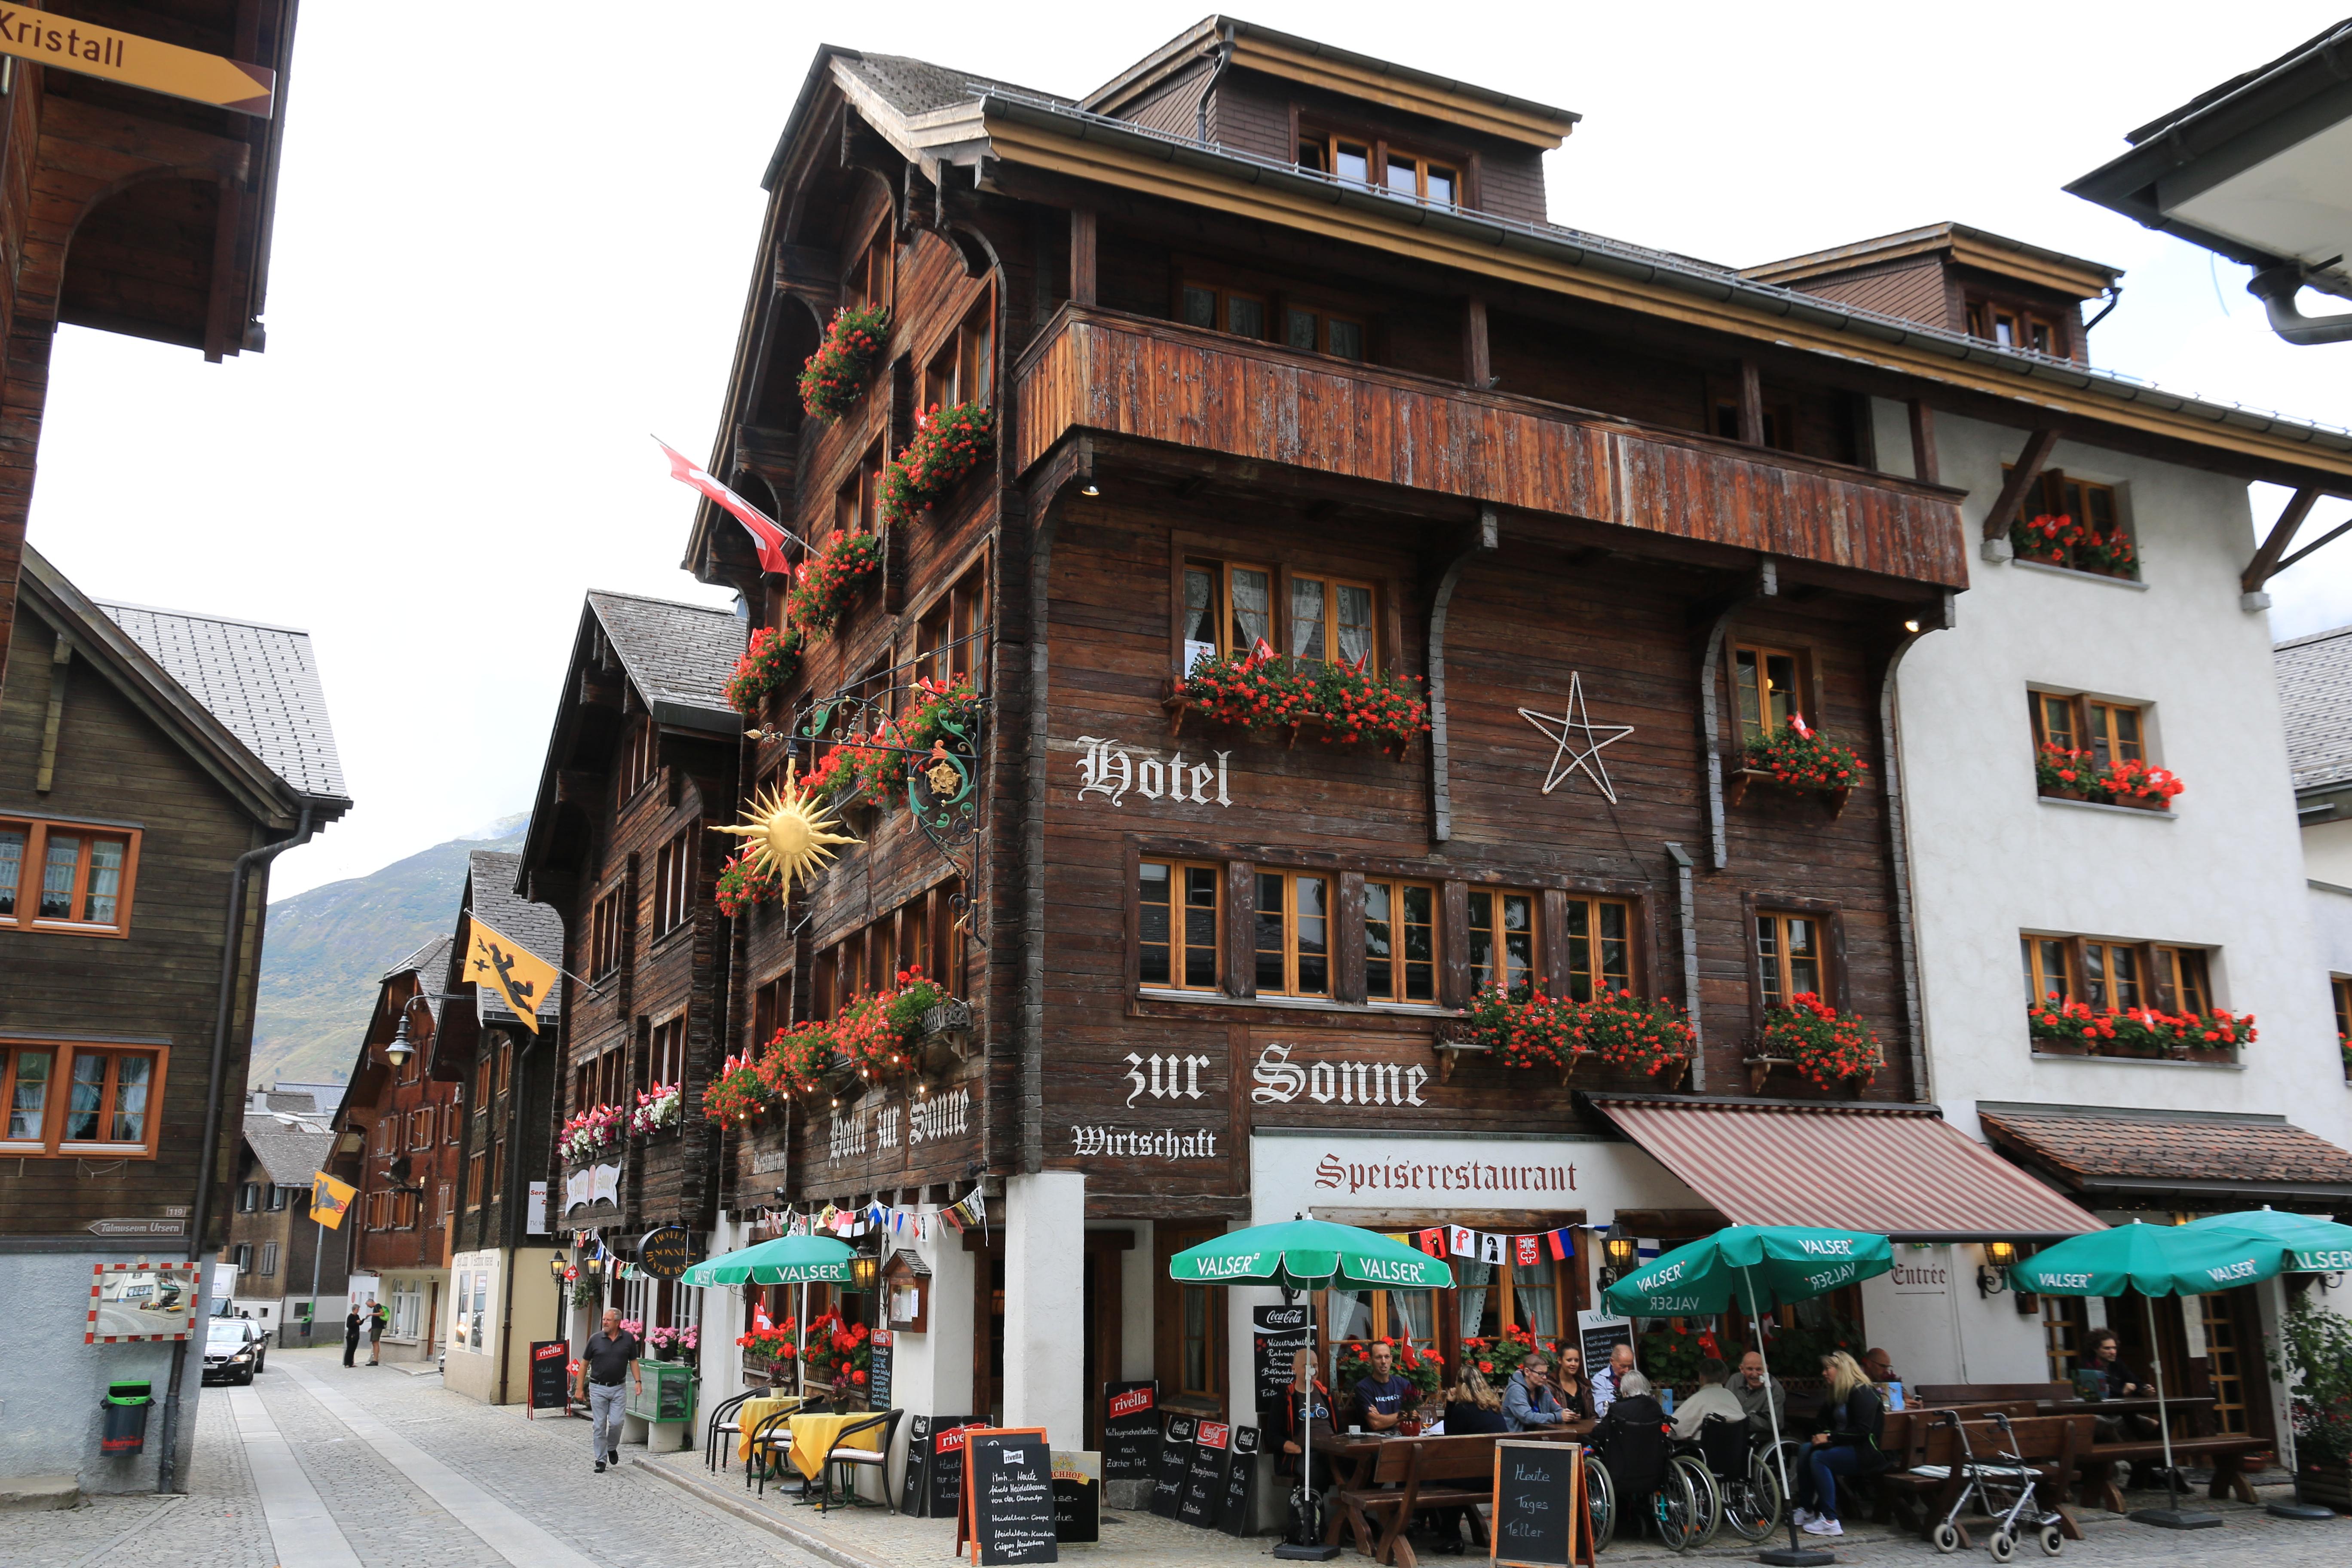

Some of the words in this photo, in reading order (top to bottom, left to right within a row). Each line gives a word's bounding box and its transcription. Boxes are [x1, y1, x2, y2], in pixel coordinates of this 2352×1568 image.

[0, 9, 123, 67] Kristall
[1075, 735, 1234, 808] Hotel
[1123, 1051, 1210, 1109] zur
[1251, 1043, 1428, 1107] Sonne
[829, 1109, 867, 1168] Hotel
[877, 1105, 901, 1159] zur
[910, 1087, 970, 1145] Sonne
[1071, 1125, 1217, 1161] Wirtschaft
[1315, 1153, 1577, 1195] Speiserestaurant
[101, 1223, 146, 1232] Talmuseum
[150, 1222, 179, 1232] Ursern
[654, 1231, 686, 1244] HOTEL
[1798, 1239, 1852, 1255] VALSER
[655, 1248, 686, 1256] SONNE
[776, 1265, 840, 1281] VALSER
[1197, 1256, 1251, 1276] VALSER
[1360, 1257, 1423, 1283] VALSER
[2206, 1261, 2257, 1282] VALSER
[1636, 1264, 1682, 1292] VALSER
[2039, 1273, 2088, 1289] VALSER
[1267, 1310, 1303, 1323] Coca-Cola
[540, 1346, 560, 1357] rivella
[1115, 1392, 1147, 1411] rivella
[1005, 1453, 1022, 1461] rivella
[1017, 1469, 1038, 1481] Heute
[1051, 1470, 1083, 1479] ICHHOF
[1515, 1464, 1550, 1482] Heute
[1515, 1494, 1548, 1514] Tages
[1505, 1518, 1544, 1537] Teller
